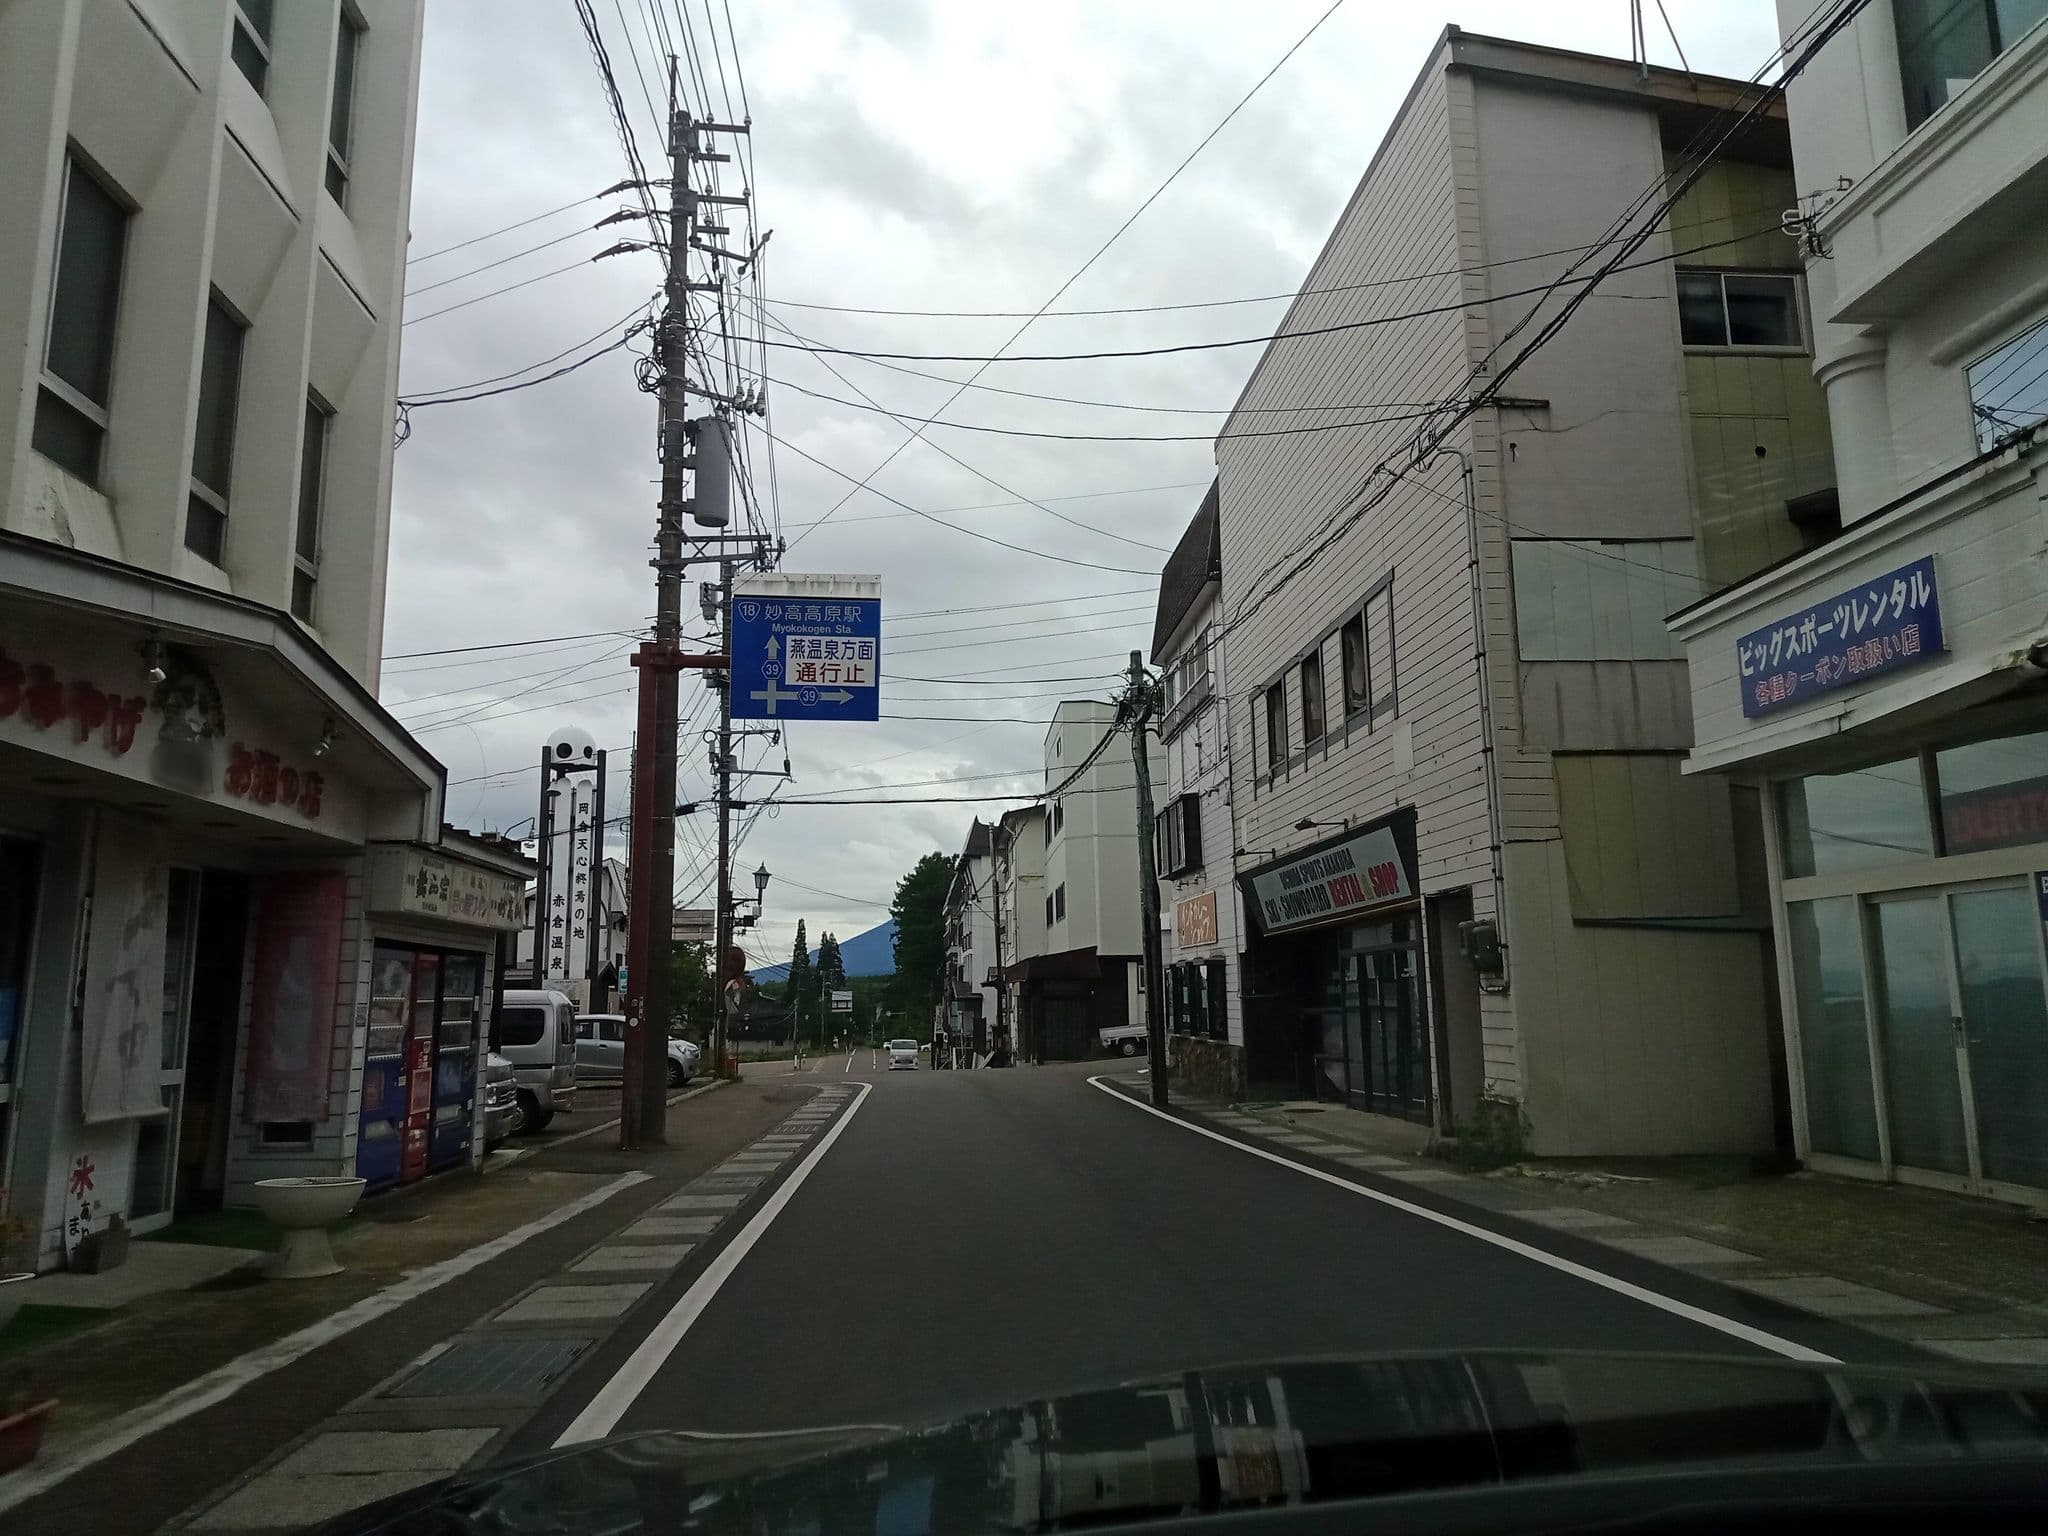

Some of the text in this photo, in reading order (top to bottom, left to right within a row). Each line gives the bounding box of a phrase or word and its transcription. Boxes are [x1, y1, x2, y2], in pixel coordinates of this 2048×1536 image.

[742, 604, 756, 617] 18
[764, 604, 862, 623] 妙高高原駅
[772, 623, 831, 634] Myokokogen
[1739, 570, 1931, 677] ビッグスポーツレンタル
[790, 639, 874, 661] 燕温泉方面
[765, 664, 779, 675] 39
[795, 662, 865, 684] 通行止
[1755, 623, 1921, 707] 各種クーポン取扱い店
[802, 690, 816, 702] 39
[572, 802, 590, 939] 岡倉天心終焉の地
[1327, 873, 1365, 908] RENTAL
[1368, 861, 1400, 898] SHOP
[550, 893, 565, 970] 赤倉温泉
[69, 1154, 96, 1201] 氷
